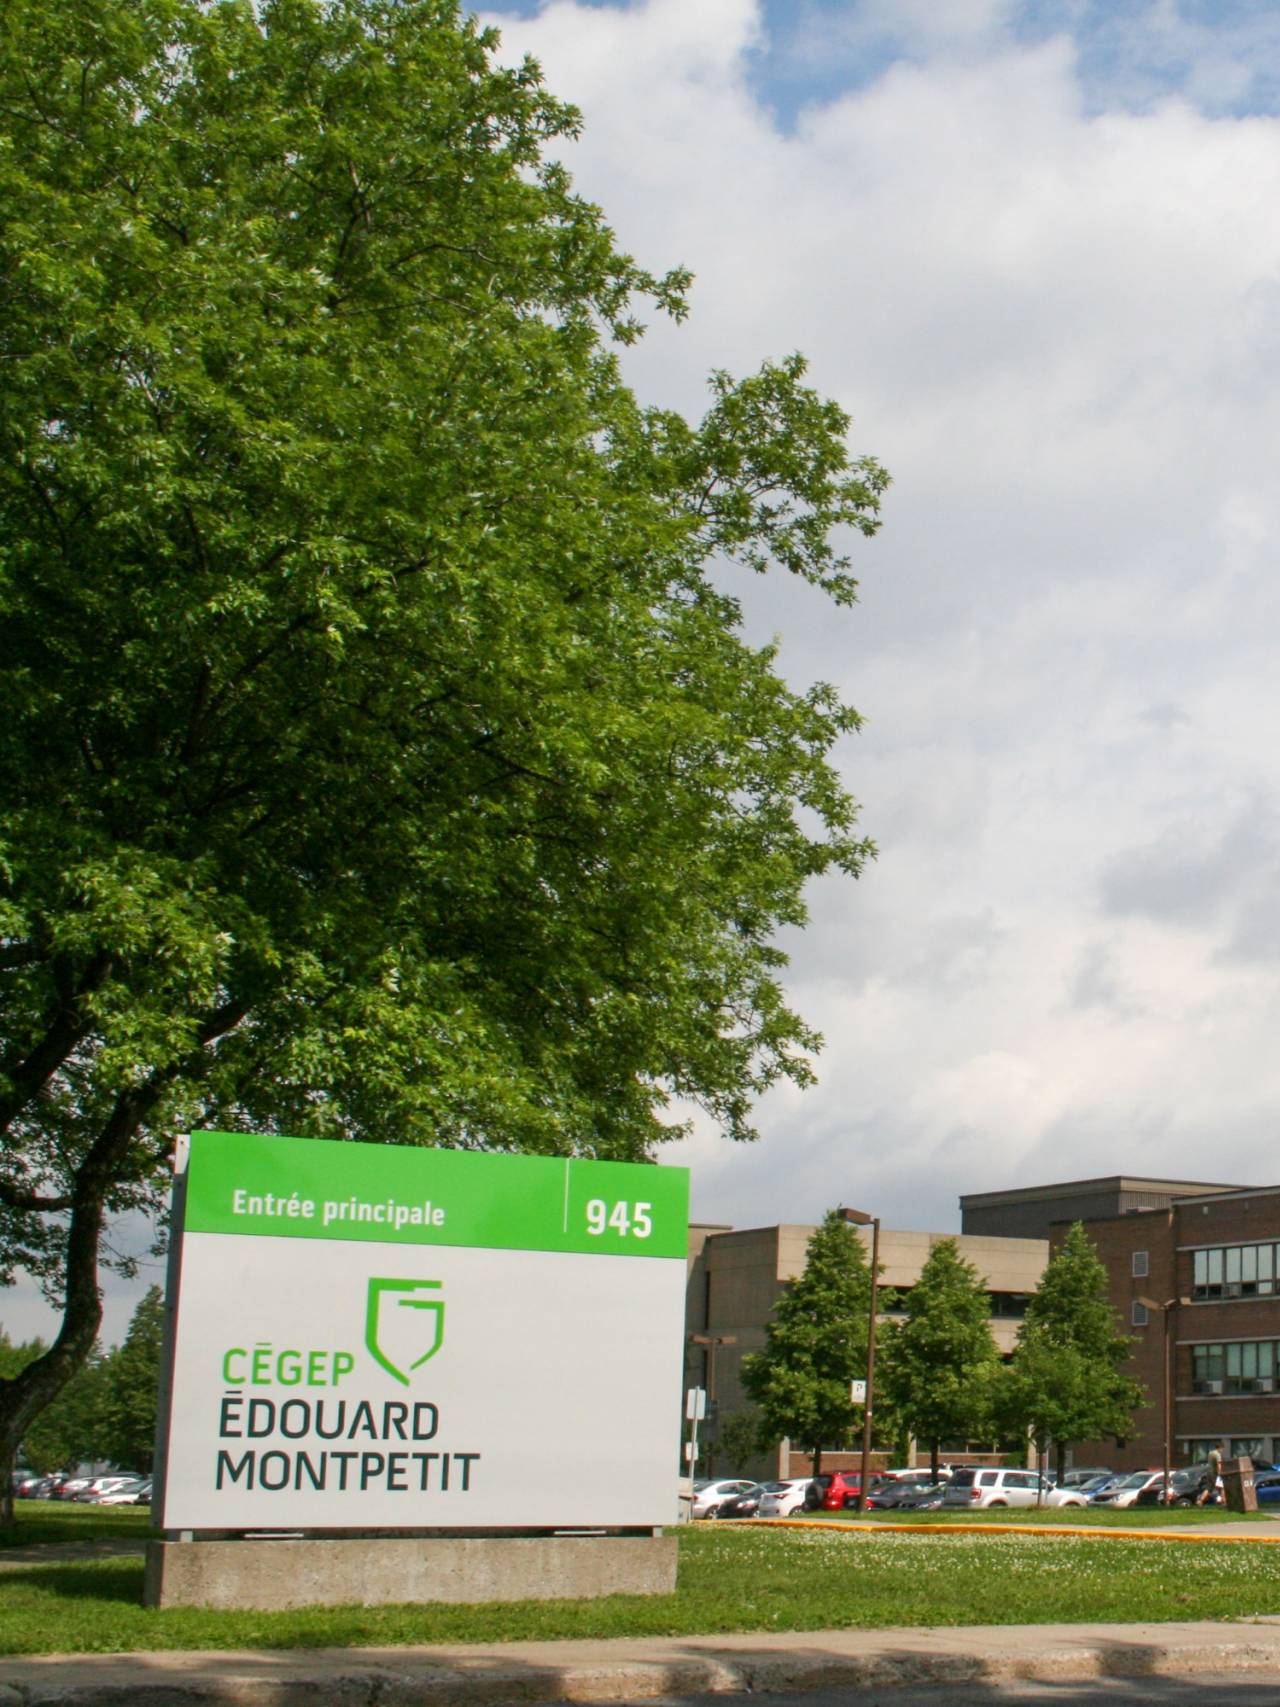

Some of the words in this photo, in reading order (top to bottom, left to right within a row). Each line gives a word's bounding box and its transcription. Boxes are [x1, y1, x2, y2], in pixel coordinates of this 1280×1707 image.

[232, 1189, 315, 1219] Entrée
[322, 1196, 445, 1231] principale
[585, 1199, 652, 1238] 945
[215, 1450, 481, 1491] MONTPETIT
